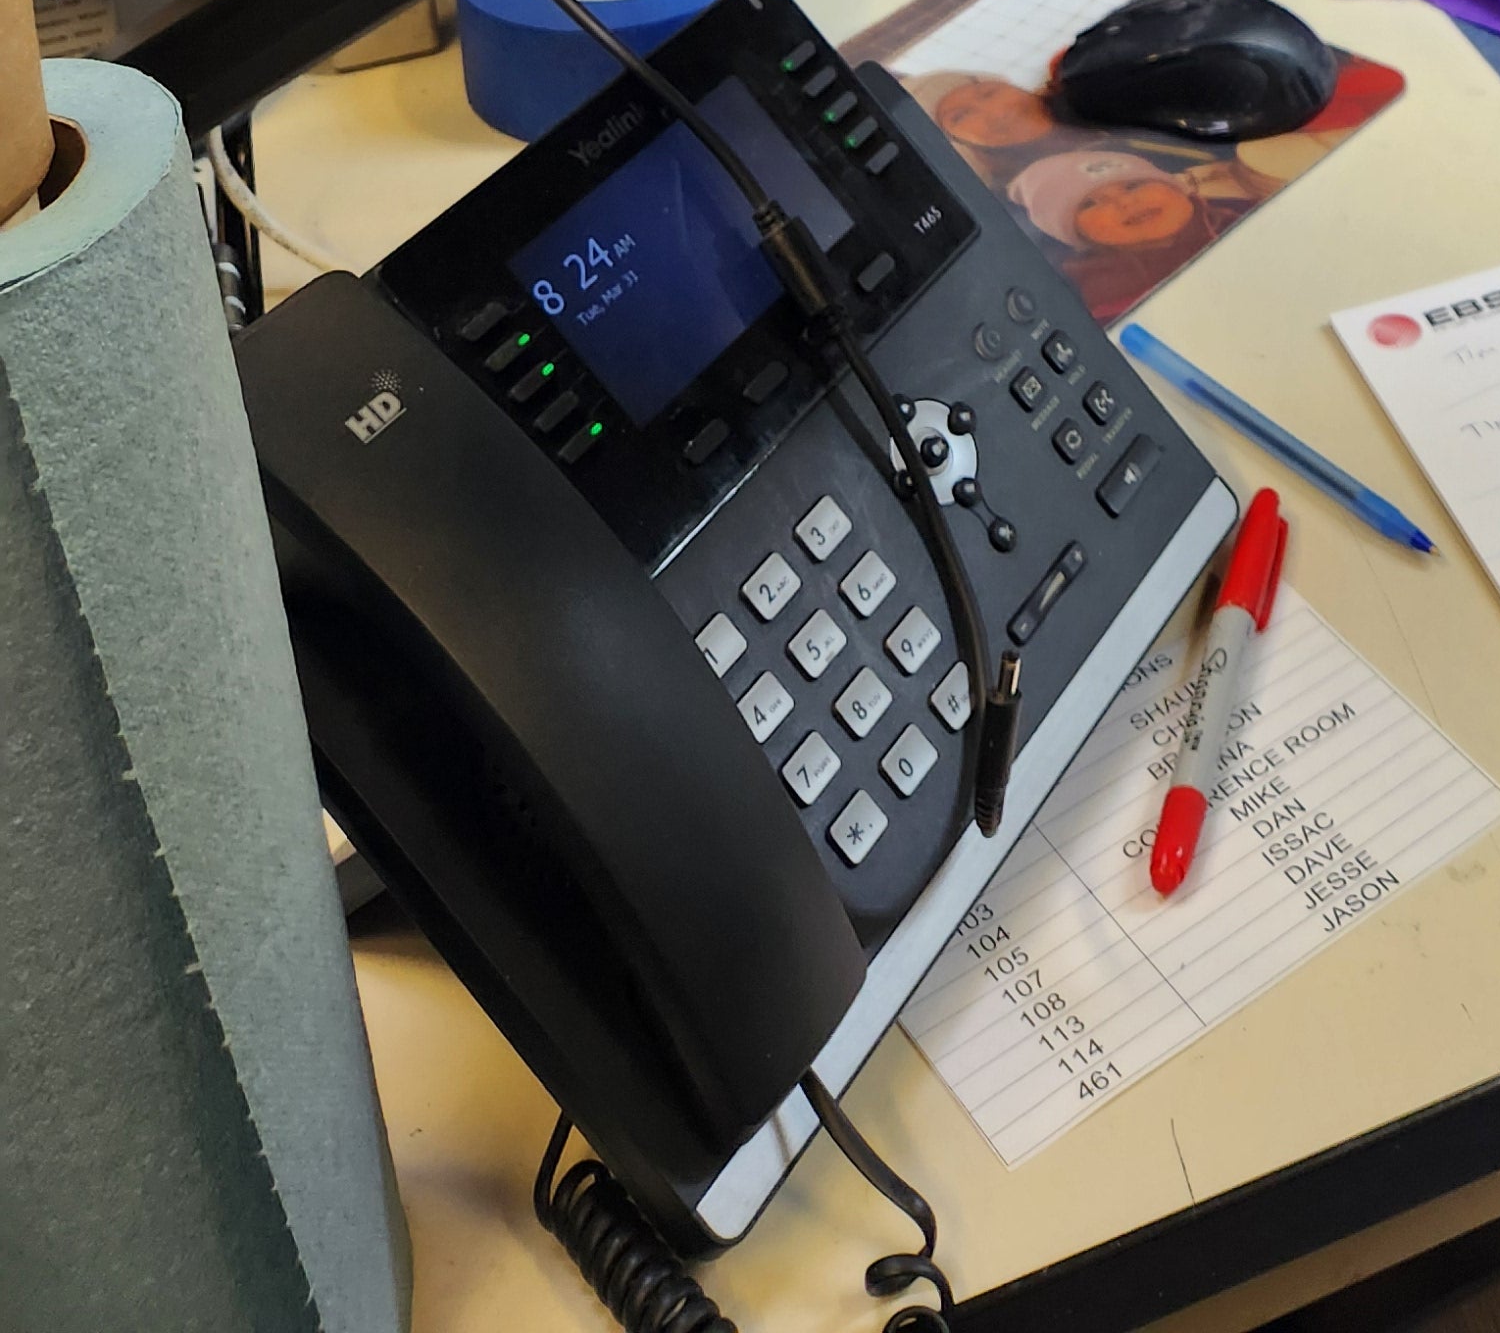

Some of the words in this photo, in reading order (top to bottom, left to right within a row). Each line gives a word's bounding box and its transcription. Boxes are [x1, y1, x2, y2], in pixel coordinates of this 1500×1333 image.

[913, 206, 942, 235] T46S
[533, 278, 566, 316] 8
[562, 237, 614, 291] 24
[612, 234, 637, 259] AM
[576, 303, 607, 326] Tue,
[601, 283, 623, 307] Mar
[622, 269, 639, 289] 31
[345, 391, 403, 441] HD
[810, 526, 826, 547] 3
[759, 582, 777, 604] 2
[858, 583, 872, 602] 6
[806, 638, 822, 662] 5
[901, 638, 916, 659] 9
[753, 705, 768, 726] 4
[852, 700, 868, 721] 8
[1283, 702, 1356, 755] ROOM
[796, 764, 811, 789] 7
[898, 757, 913, 777] 0
[1229, 775, 1291, 822] MIKE
[966, 925, 1011, 960] 104
[1252, 797, 1307, 839] DAN
[984, 946, 1029, 982] 105
[1261, 811, 1335, 867] ISSAC
[1002, 969, 1043, 1004] 107
[1284, 833, 1353, 885] DAVE
[1020, 992, 1066, 1028] 108
[1304, 850, 1379, 910] JESSE
[1039, 1015, 1085, 1051] 113
[1323, 869, 1400, 933] JASON
[1058, 1038, 1103, 1074] 114
[1079, 1061, 1123, 1099] 461
